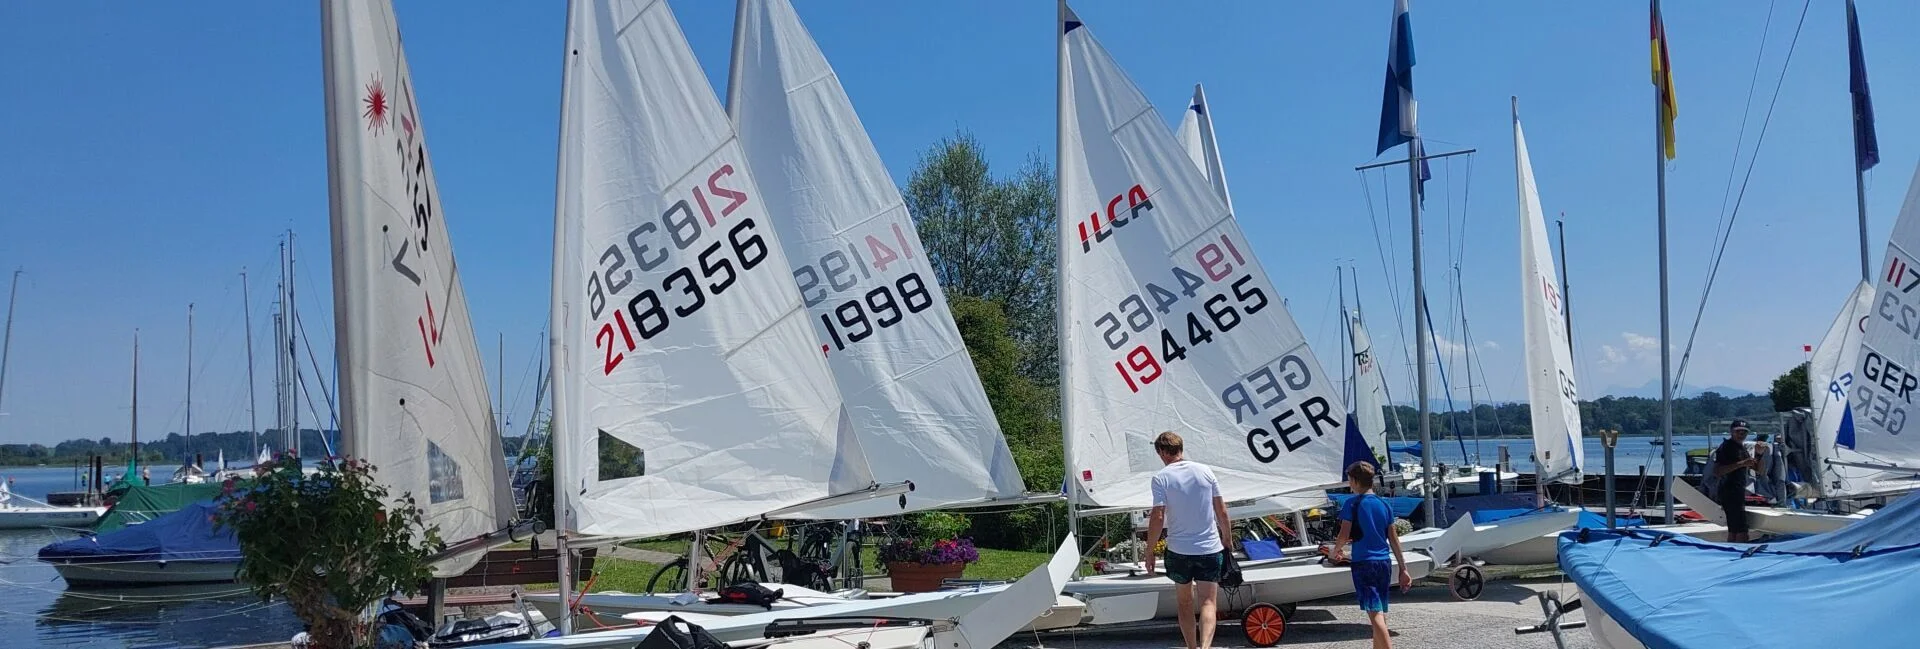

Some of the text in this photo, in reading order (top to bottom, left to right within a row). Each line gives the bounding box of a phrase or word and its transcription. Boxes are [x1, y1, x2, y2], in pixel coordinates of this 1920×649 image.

[1078, 184, 1153, 253] ILCA
[596, 218, 768, 376] 218356
[821, 272, 934, 358] 1998
[1115, 274, 1269, 393] 194465
[1864, 352, 1918, 404] GER
[1246, 396, 1341, 463] GER
